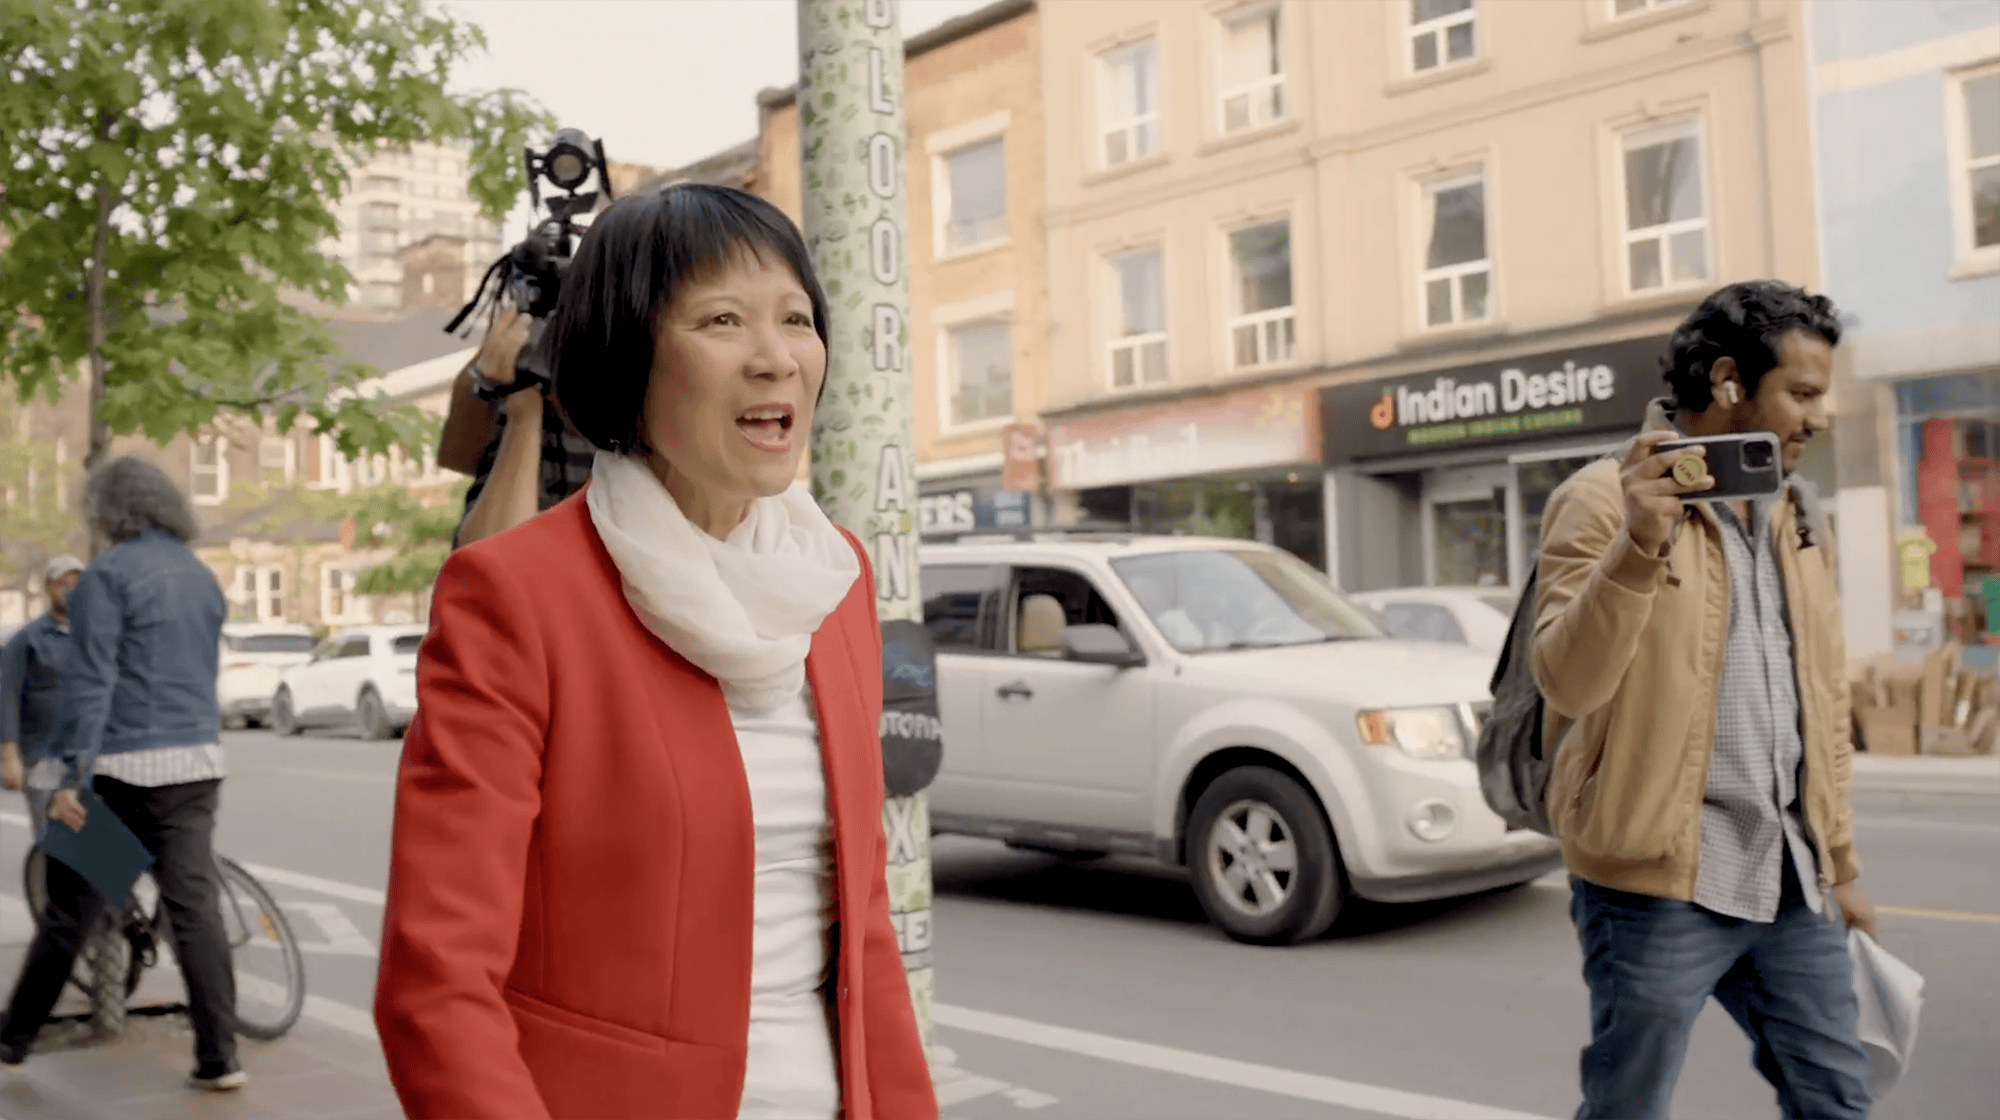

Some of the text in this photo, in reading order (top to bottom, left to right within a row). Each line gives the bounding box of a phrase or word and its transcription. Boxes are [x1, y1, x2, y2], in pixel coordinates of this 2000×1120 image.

[1397, 377, 1496, 426] Indian
[1501, 360, 1614, 412] Desire
[874, 444, 917, 866] ANX
